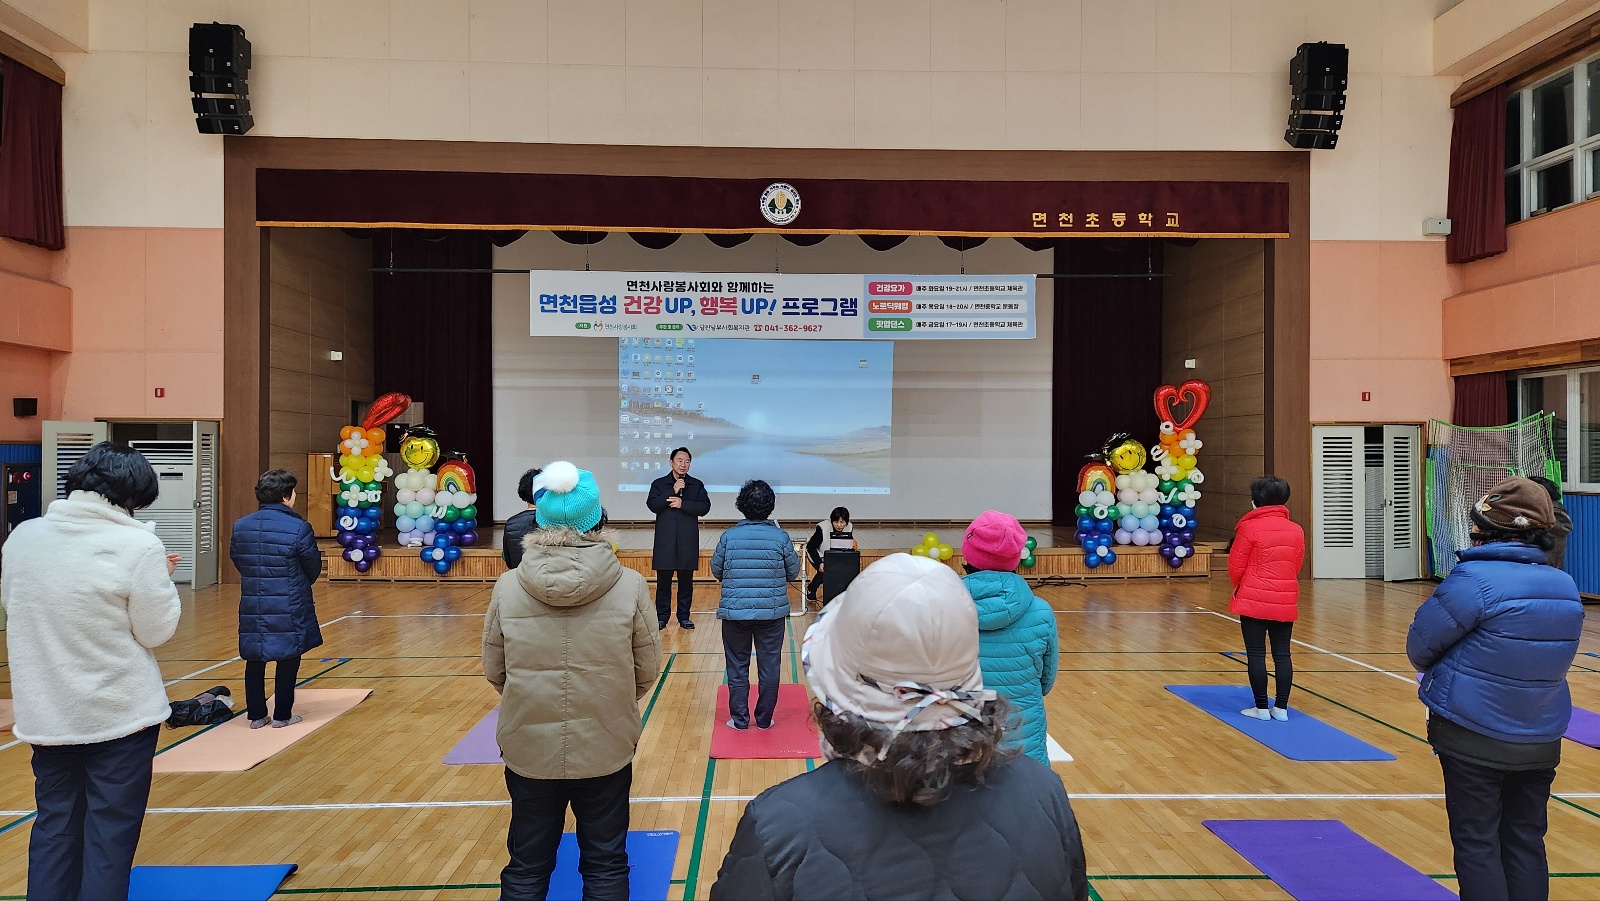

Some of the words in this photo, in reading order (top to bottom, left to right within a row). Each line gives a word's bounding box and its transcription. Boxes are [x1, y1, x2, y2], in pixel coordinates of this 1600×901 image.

[1032, 212, 1180, 228] 면천초등학교
[626, 280, 723, 293] 면천사랑봉사회와
[727, 281, 775, 294] 함께하는
[539, 293, 617, 314] 면천읍성
[623, 295, 662, 315] 건강
[665, 297, 696, 316] UP,
[700, 296, 738, 316] 행복
[741, 298, 777, 316] UP!
[781, 297, 858, 317] 프로그램
